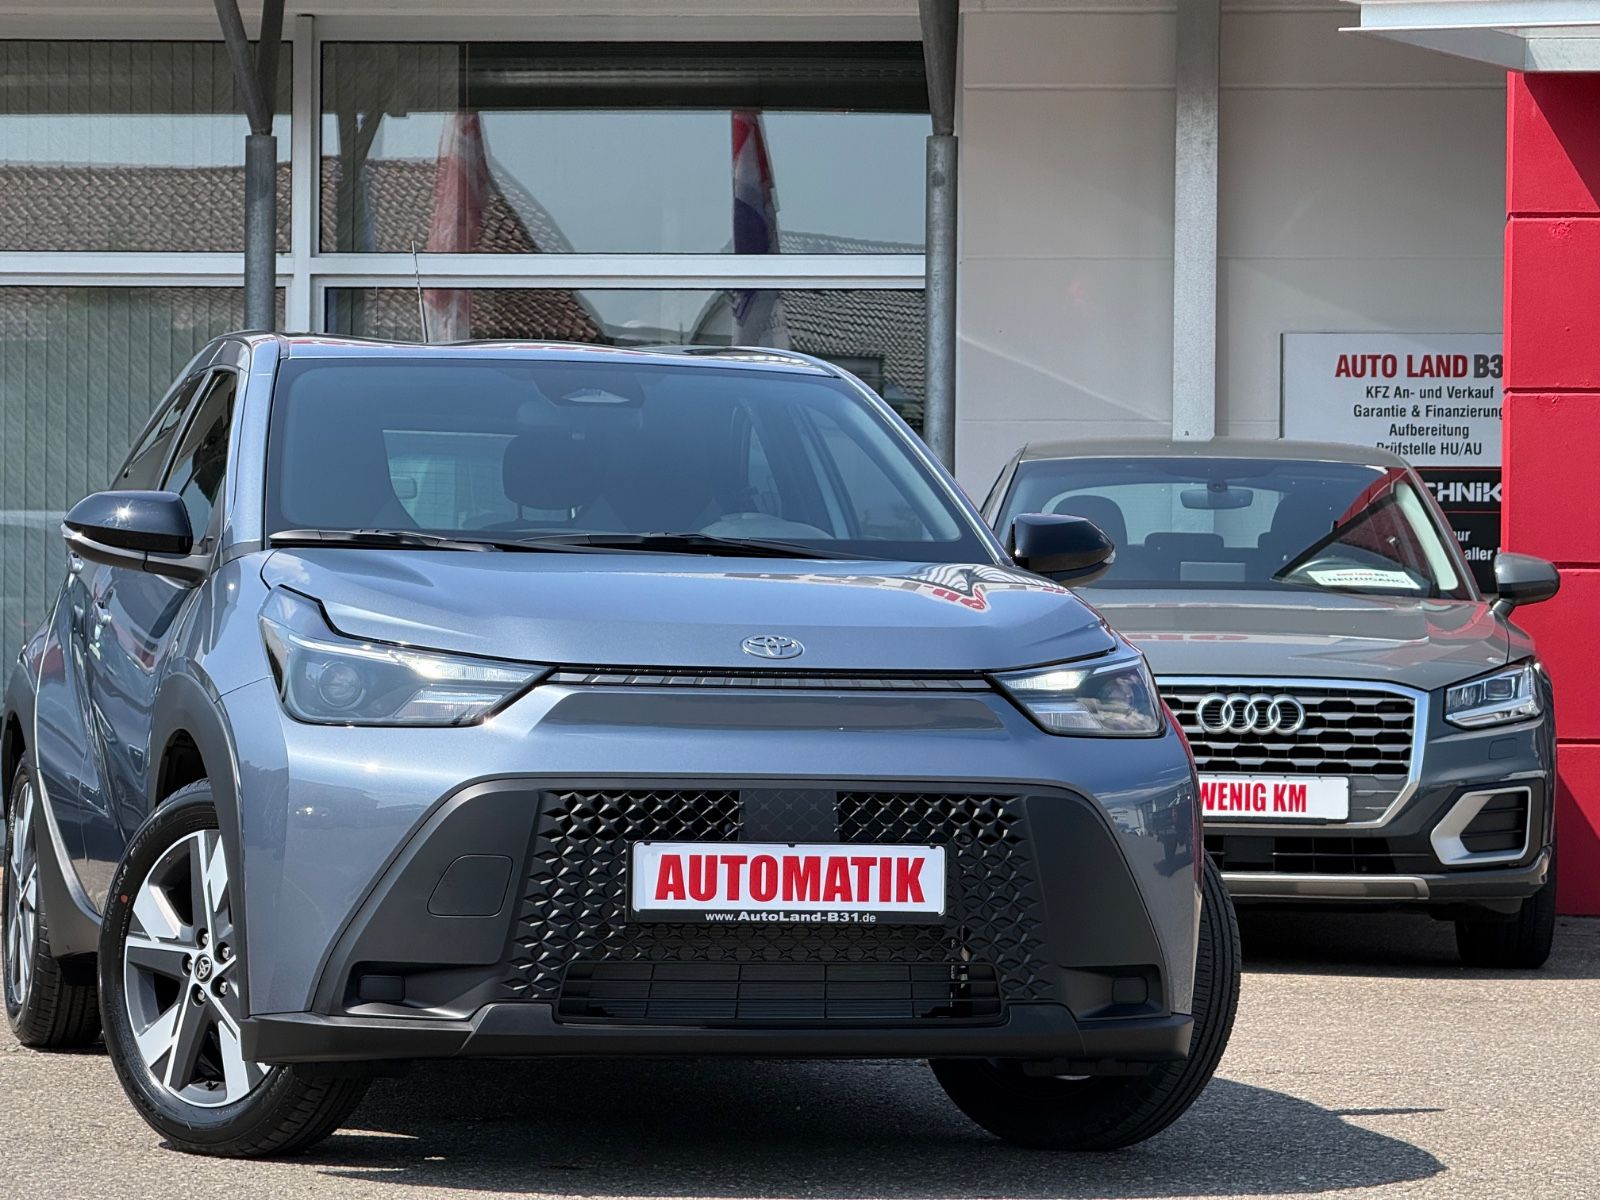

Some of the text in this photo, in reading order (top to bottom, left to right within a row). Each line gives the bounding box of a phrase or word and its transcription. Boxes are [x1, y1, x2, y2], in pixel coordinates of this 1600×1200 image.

[1334, 354, 1398, 378] AUTO
[1406, 354, 1468, 378] LAND
[1366, 386, 1494, 399] KFZ An- und Verkauf
[1353, 404, 1407, 418] Garantie
[1411, 404, 1421, 418] &
[1389, 424, 1469, 439] Aufbereitung
[1440, 442, 1482, 456] HU/AU
[1200, 782, 1307, 812] WENIG KM
[655, 854, 926, 902] AUTOMATIK
[705, 911, 876, 923] www.AutoLand-B31.de
